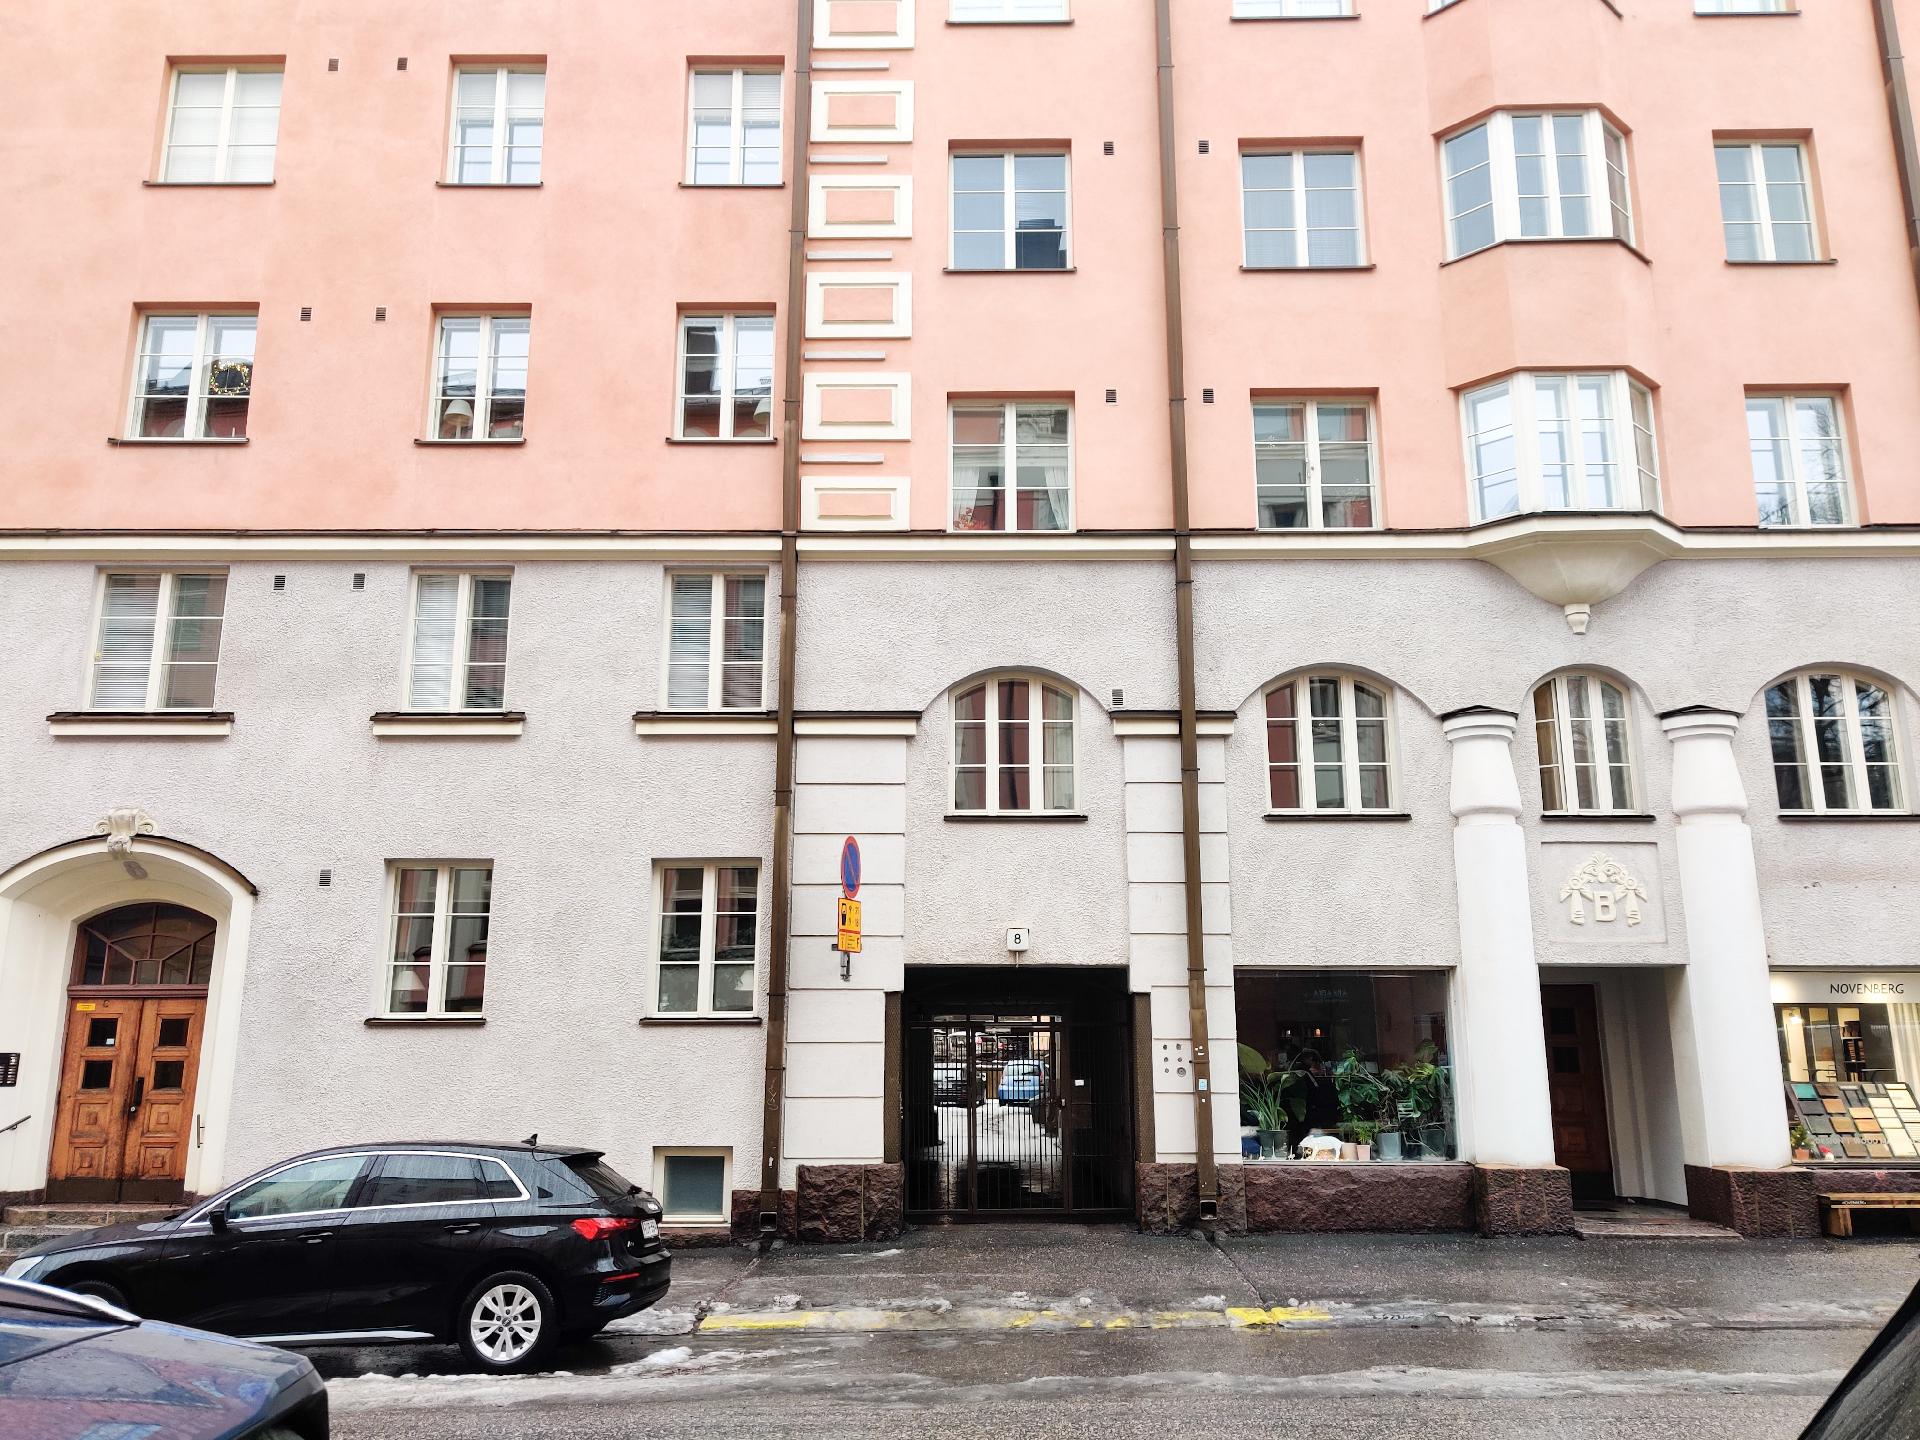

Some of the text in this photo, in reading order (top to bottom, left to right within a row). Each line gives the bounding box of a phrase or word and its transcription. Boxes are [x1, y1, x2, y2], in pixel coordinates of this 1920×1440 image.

[1593, 891, 1617, 922] B
[1014, 933, 1021, 945] 8
[1830, 983, 1904, 995] NOVENBERG
